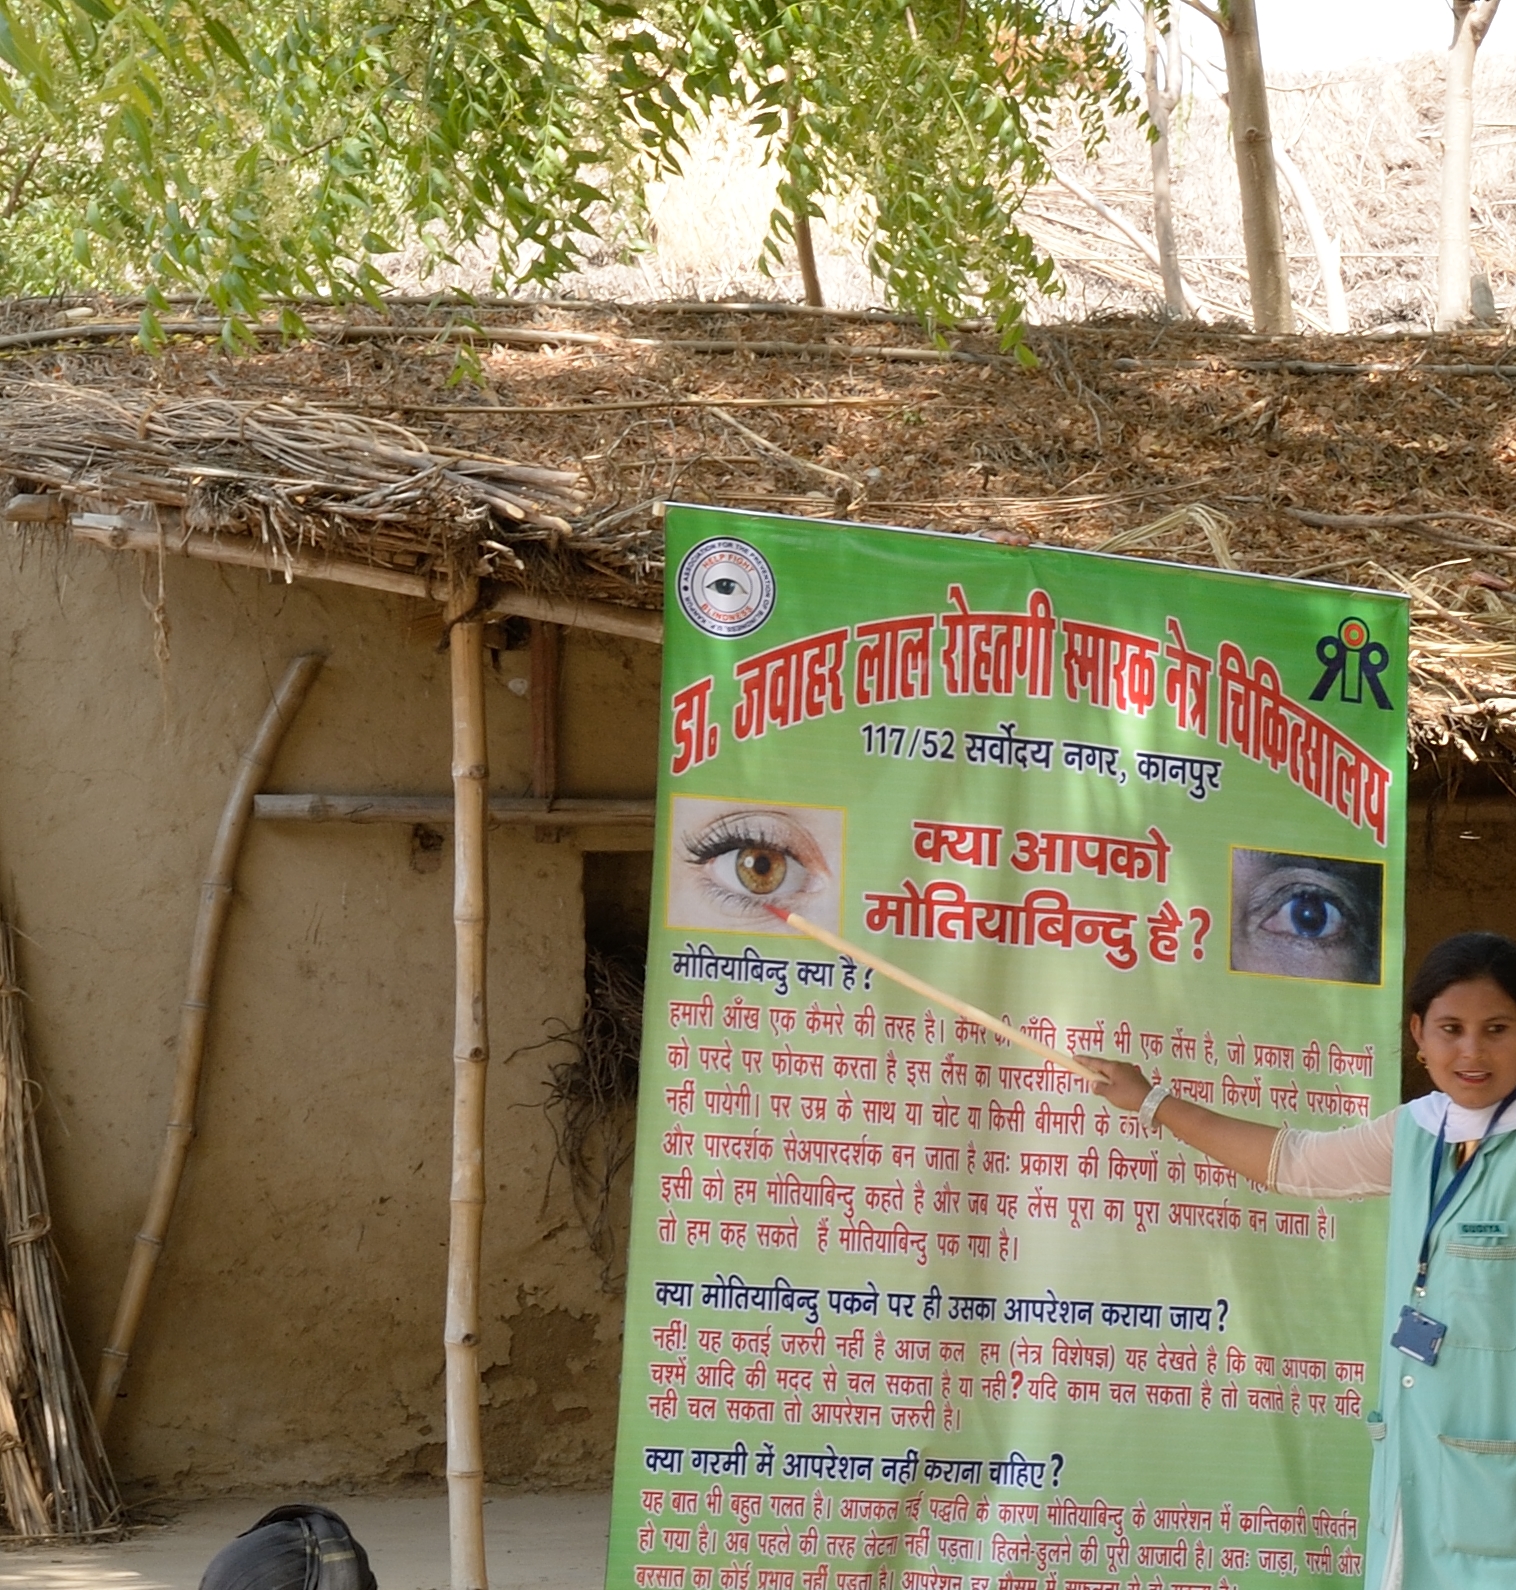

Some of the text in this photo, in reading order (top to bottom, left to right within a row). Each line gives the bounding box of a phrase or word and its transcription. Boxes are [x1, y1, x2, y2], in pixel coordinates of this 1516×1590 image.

[702, 554, 755, 573] HELP FIGHT
[700, 603, 754, 621] BLINDNESS
[734, 629, 849, 740] जवाहर
[856, 616, 935, 706] लाल
[941, 584, 1056, 697] रोहतगी
[1062, 619, 1159, 716] स्मारक
[1165, 617, 1212, 740] नेत्र
[1217, 641, 1390, 846] चिकित्सालय
[861, 723, 955, 760] 117/52
[965, 722, 1054, 770] सर्वोदय
[1137, 751, 1222, 799] कानपुर
[912, 821, 1171, 884] क्या आपको
[864, 879, 1138, 970] मोतियाबिन्दु
[672, 943, 789, 995] मोतियाबिन्दु
[796, 962, 836, 986] क्या
[669, 995, 715, 1027] हमारी
[723, 999, 761, 1029] आँख
[768, 1009, 797, 1035] एक
[805, 1002, 845, 1034] कैमरे
[854, 1005, 876, 1037] की
[884, 1016, 916, 1042] तरह
[1065, 1021, 1105, 1054] इसमें
[1113, 1022, 1133, 1053] भी
[1139, 1034, 1164, 1059] एक
[1227, 1035, 1246, 1065] जो
[1253, 1045, 1295, 1069] प्रकाश
[1302, 1041, 1321, 1071] की
[1327, 1044, 1374, 1076] किरणों
[663, 1124, 695, 1155] और
[703, 1128, 774, 1160] पारदर्शक
[891, 1145, 916, 1168] बन
[925, 1147, 961, 1170] जाता
[966, 1144, 977, 1174] है
[1019, 1153, 1069, 1176] प्रकाश
[1077, 1146, 1100, 1178] की
[1107, 1148, 1159, 1181] किरणों
[1167, 1154, 1187, 1183] को
[659, 1211, 678, 1241] तो
[686, 1221, 711, 1245] हम
[720, 1223, 748, 1248] कह
[756, 1217, 800, 1247] सकते
[817, 1218, 830, 1252] हैं
[839, 1216, 930, 1265] मोतियाबिन्दु
[936, 1234, 961, 1256] पक
[966, 1235, 992, 1257] गया
[655, 1282, 695, 1306] क्या
[700, 1274, 820, 1324] मोतियाबिन्दु
[827, 1282, 880, 1315] पकने
[886, 1294, 916, 1317] पर
[922, 1285, 943, 1320] ही
[948, 1296, 998, 1321] उसका
[1003, 1290, 1095, 1325] आपरेशन
[1100, 1303, 1163, 1328] कराया
[698, 1331, 723, 1353] यह
[732, 1325, 772, 1357] कतई
[781, 1327, 827, 1355] जरुरी
[836, 1329, 865, 1359] नहीं
[874, 1331, 886, 1360] है
[895, 1340, 931, 1360] आज
[939, 1342, 965, 1361] कल
[980, 1343, 1001, 1365] हम
[1125, 1349, 1148, 1371] यह
[1157, 1343, 1198, 1371] देखते
[1205, 1345, 1219, 1374] है
[1225, 1346, 1246, 1373] कि
[1254, 1356, 1275, 1375] क्या
[1282, 1359, 1327, 1379] आपका
[1335, 1362, 1365, 1381] काम
[649, 1389, 679, 1419] नही
[687, 1398, 717, 1418] चल
[726, 1400, 775, 1421] सकता
[784, 1395, 803, 1422] तो
[811, 1397, 882, 1425] आपरेशन
[891, 1400, 936, 1428] जरुरी
[645, 1449, 685, 1472] क्या
[691, 1442, 749, 1475] गरमी
[755, 1443, 776, 1476] में
[782, 1445, 874, 1480] आपरेशन
[880, 1449, 920, 1485] नहीं
[924, 1459, 984, 1484] कराना
[636, 1567, 686, 1586] बरसात
[693, 1569, 713, 1588] का
[758, 1571, 795, 1590] प्रभाव
